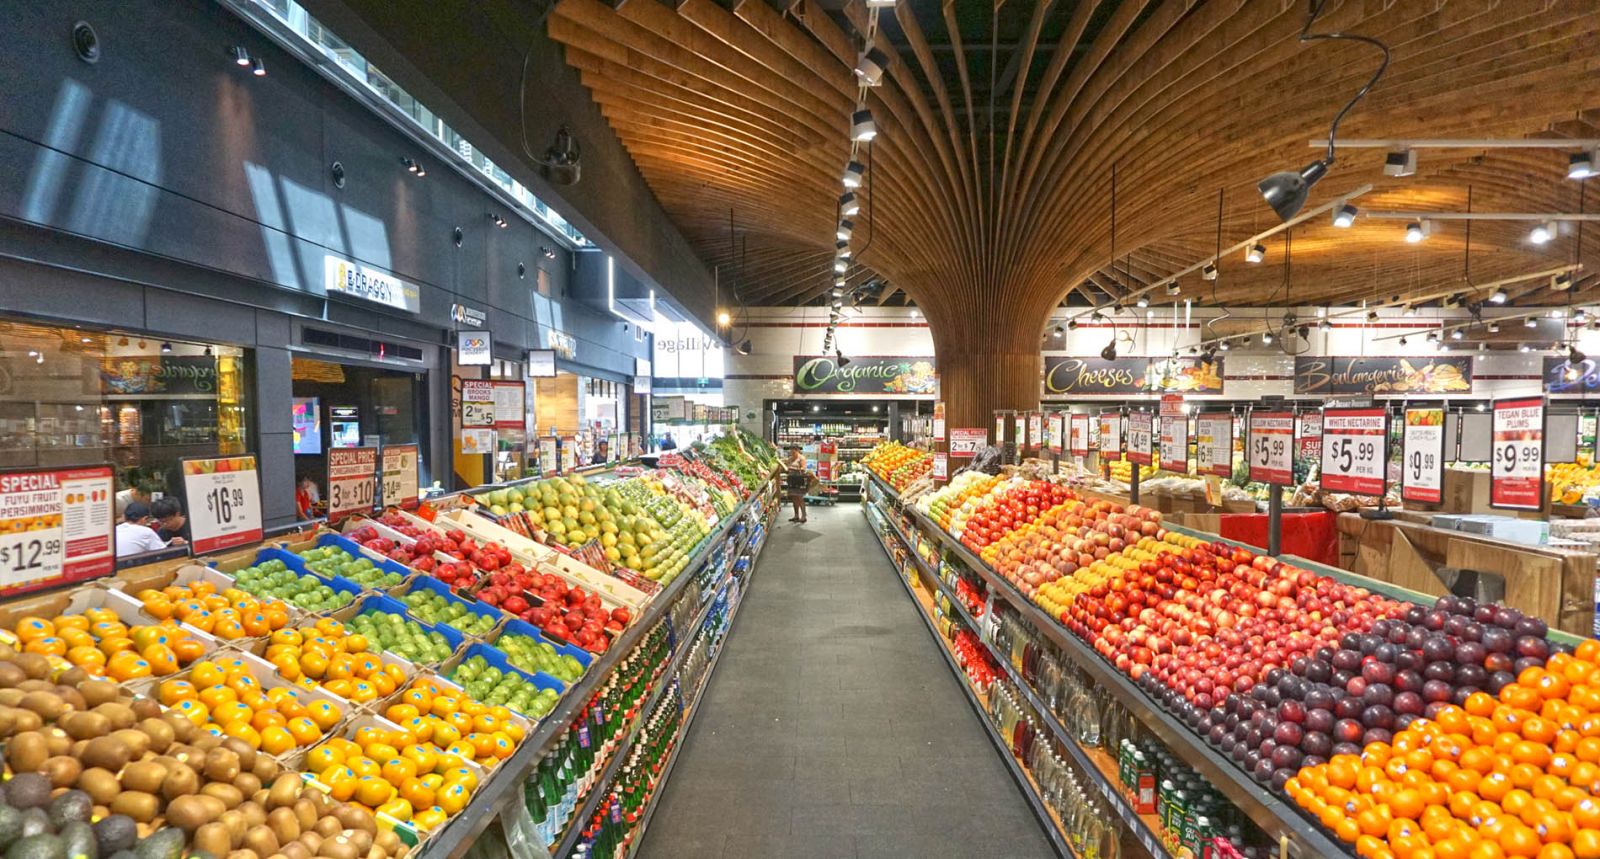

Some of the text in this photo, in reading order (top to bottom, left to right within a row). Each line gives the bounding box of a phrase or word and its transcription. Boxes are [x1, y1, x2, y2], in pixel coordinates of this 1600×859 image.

[797, 358, 898, 392] Organic
[1046, 360, 1133, 393] Cheeses
[1295, 359, 1407, 393] Boulangerie
[464, 381, 493, 389] SPECIAL
[465, 406, 473, 417] 2
[481, 413, 493, 424] $5
[1329, 418, 1382, 427] WHITE NECTARINE
[1498, 408, 1540, 420] TEGAN BLUE
[1506, 418, 1530, 428] PLUMS
[1303, 424, 1310, 433] 2
[952, 442, 958, 451] 2
[1255, 437, 1285, 465] $5.99
[331, 452, 357, 465] SPECIAL
[358, 451, 375, 463] PRICE
[1331, 439, 1375, 473] $5.99
[1496, 444, 1539, 472] $9.99
[1409, 451, 1434, 480] $9.99
[0, 474, 60, 492] SPECIAL
[5, 491, 58, 506] FUYU FRUIT
[332, 480, 372, 508] 3 for $10
[0, 502, 62, 518] PERSIMMONS
[206, 487, 244, 524] $16.99
[0, 538, 61, 572] $12.99
